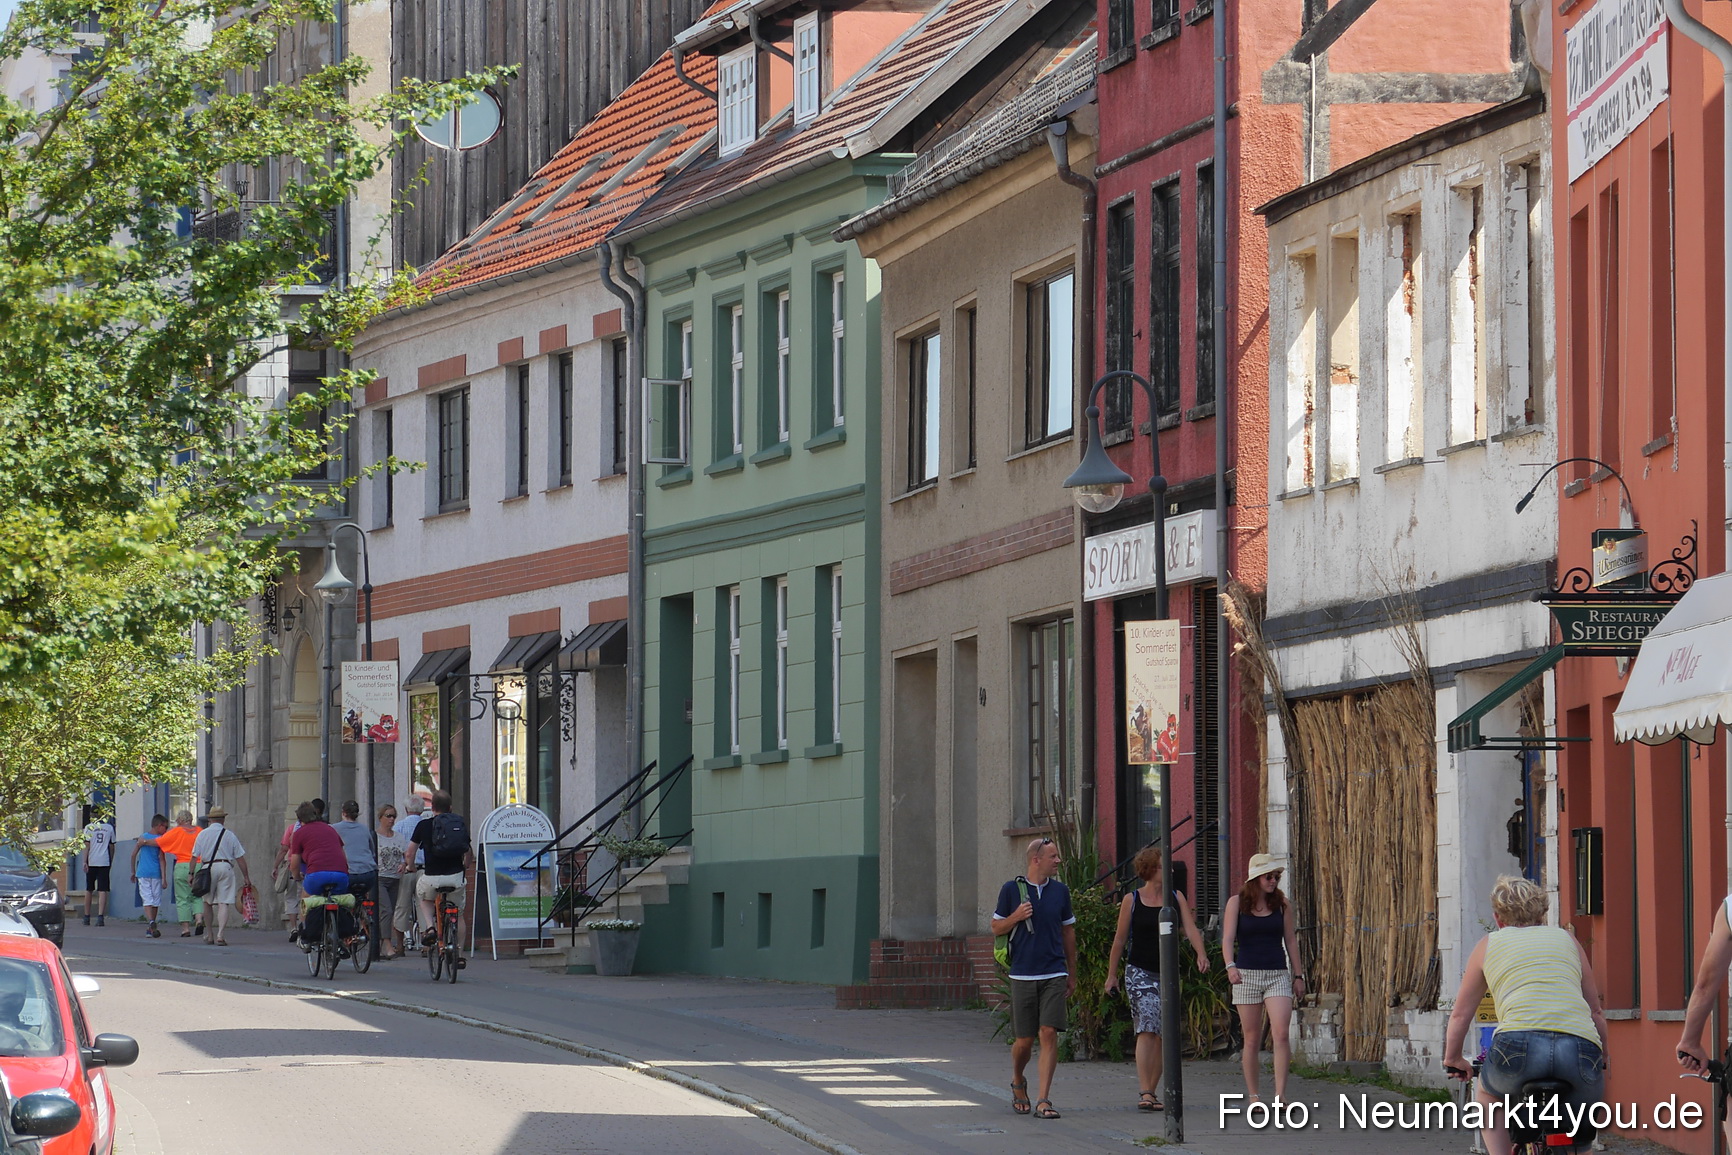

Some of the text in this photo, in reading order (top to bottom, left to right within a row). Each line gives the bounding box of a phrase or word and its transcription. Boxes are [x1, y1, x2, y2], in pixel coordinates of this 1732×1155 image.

[1088, 538, 1142, 590] SPORT
[1167, 526, 1180, 572] &
[1186, 524, 1197, 568] E
[1135, 641, 1177, 654] Sommerfest
[96, 833, 104, 844] 9
